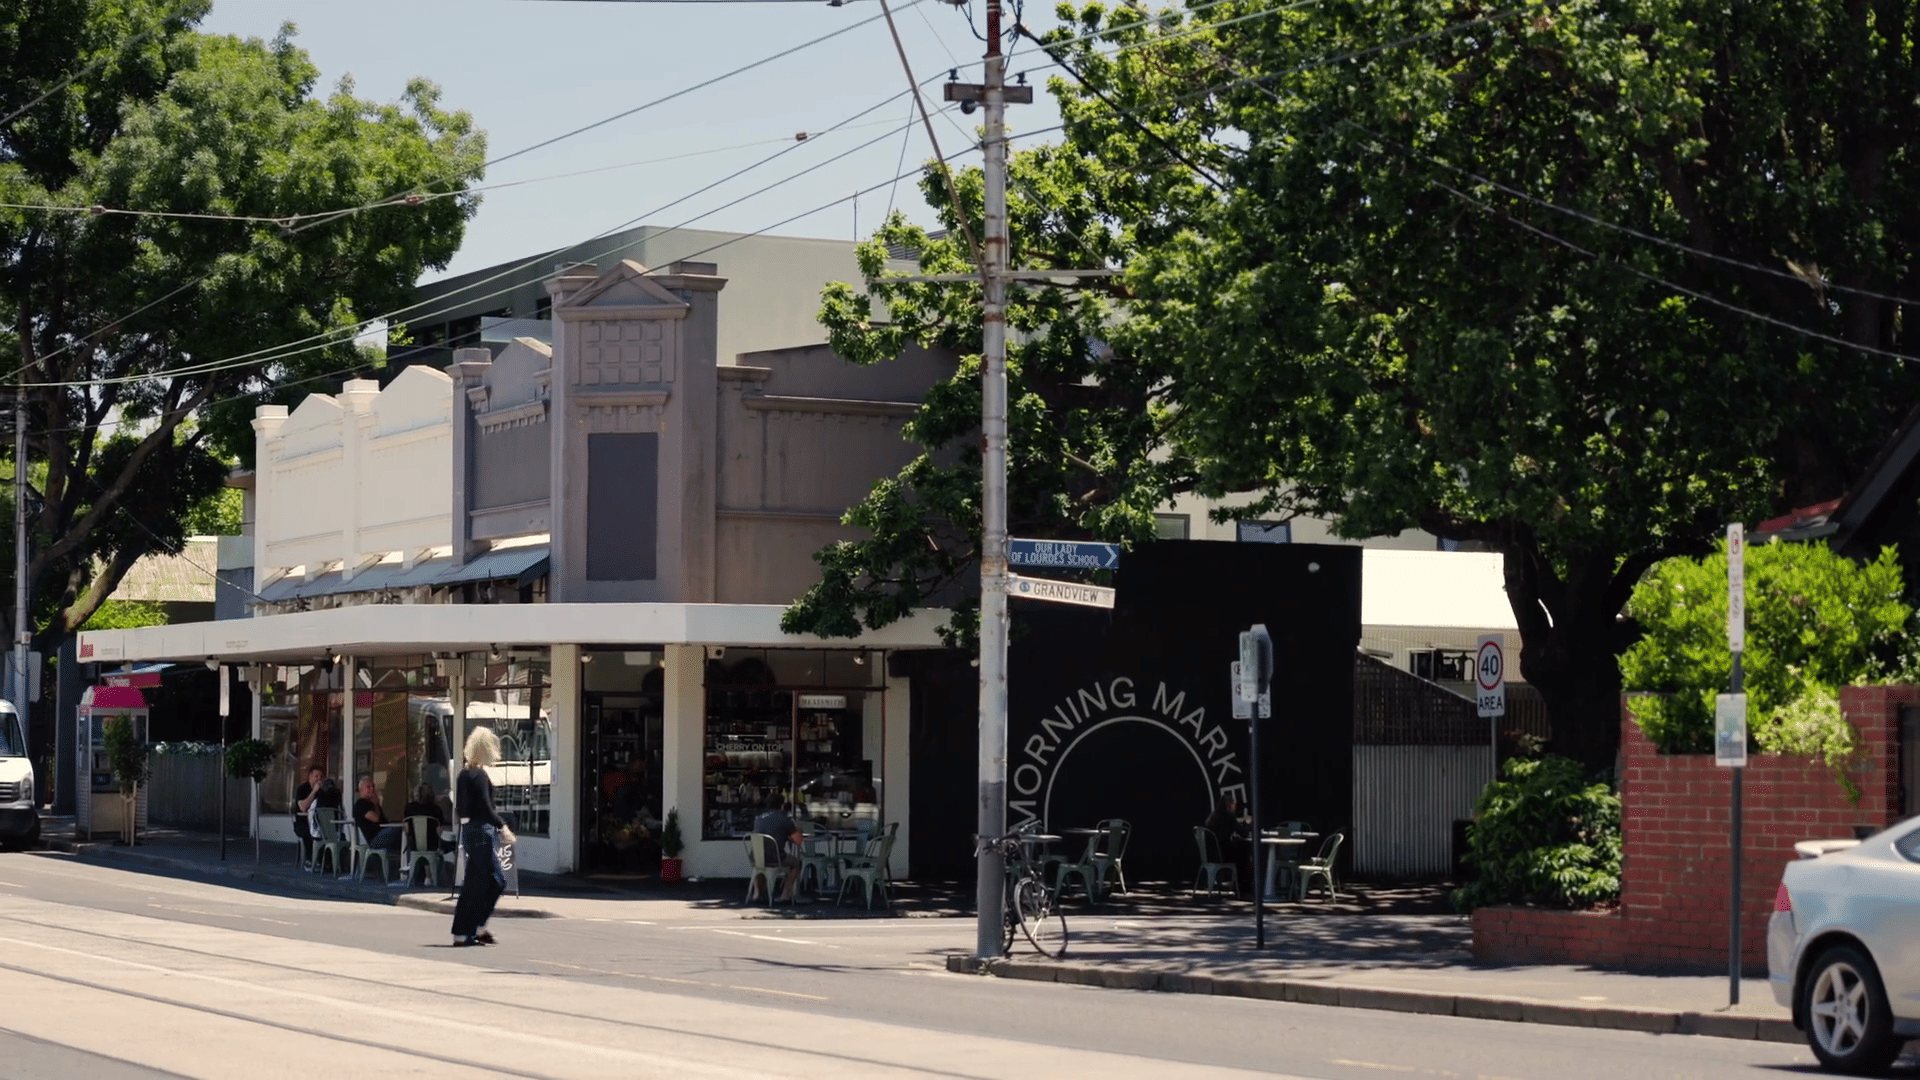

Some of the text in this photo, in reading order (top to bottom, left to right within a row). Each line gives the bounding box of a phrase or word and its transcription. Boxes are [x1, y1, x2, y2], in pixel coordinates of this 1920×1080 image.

[1034, 542, 1078, 555] OUR LADY
[1011, 551, 1099, 566] OF LOURDES SCHOOL
[1034, 582, 1099, 602] GRANDVIEW
[1481, 655, 1499, 675] 40
[1479, 696, 1503, 710] AREA
[715, 742, 784, 752] CHERRY ON TOP
[1008, 676, 1137, 833] MORNING
